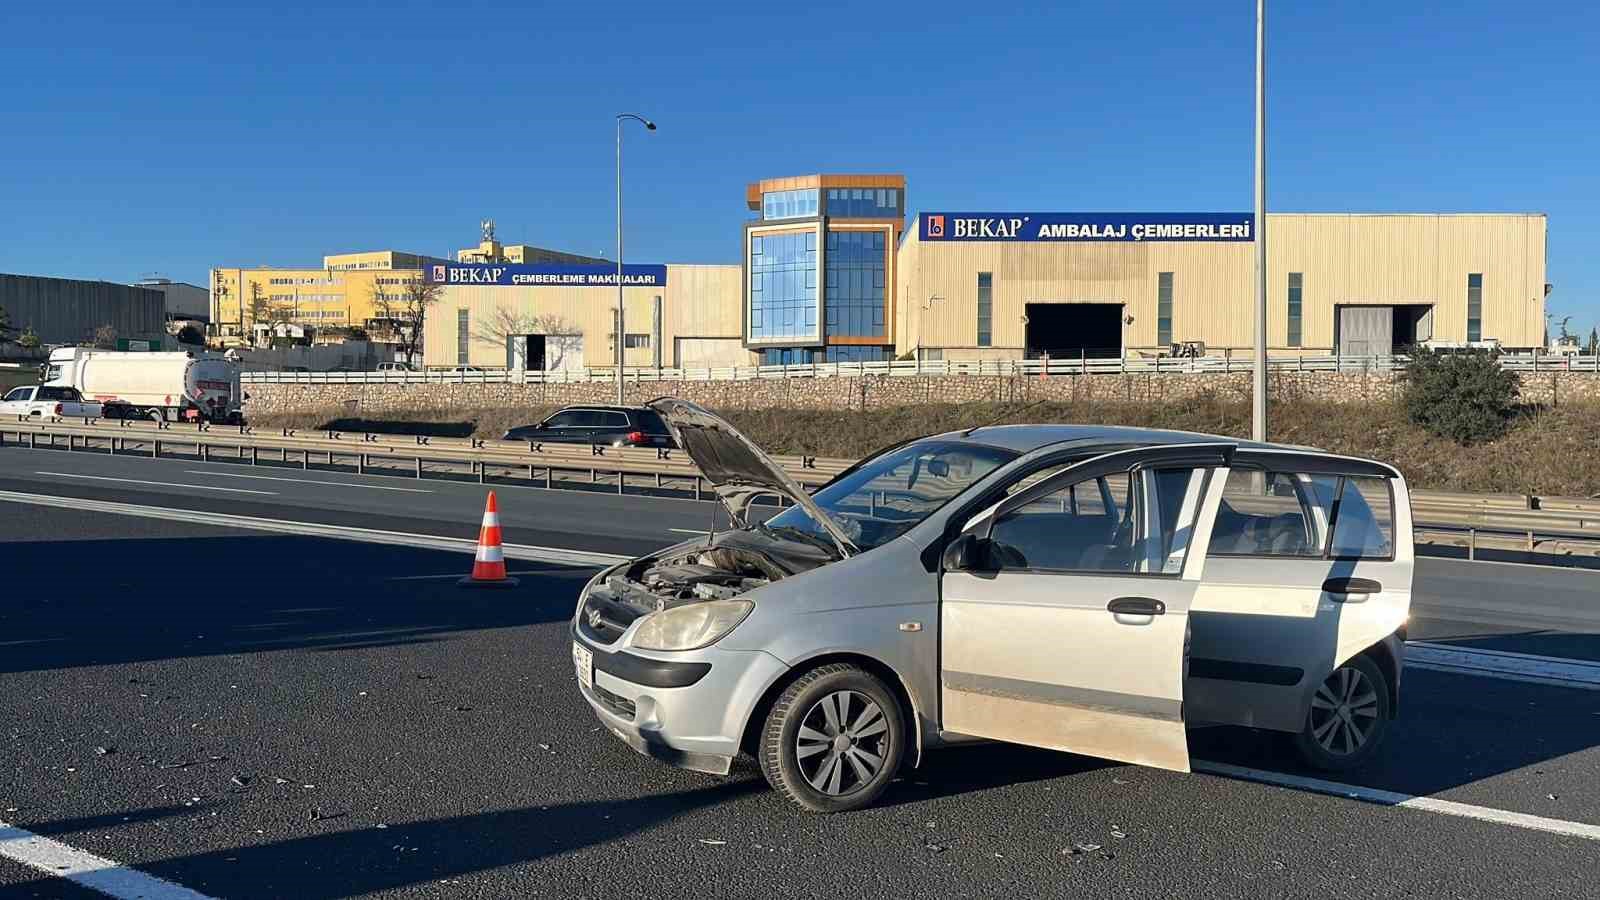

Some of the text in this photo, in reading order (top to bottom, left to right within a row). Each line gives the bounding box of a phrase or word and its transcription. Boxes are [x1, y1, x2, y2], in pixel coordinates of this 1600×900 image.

[953, 218, 1022, 238] BEKAP
[1038, 220, 1250, 241] AMBALAJ ÇEMBERLERİ
[450, 267, 502, 283] BEKAP
[512, 274, 585, 285] ÇEMBERLEME
